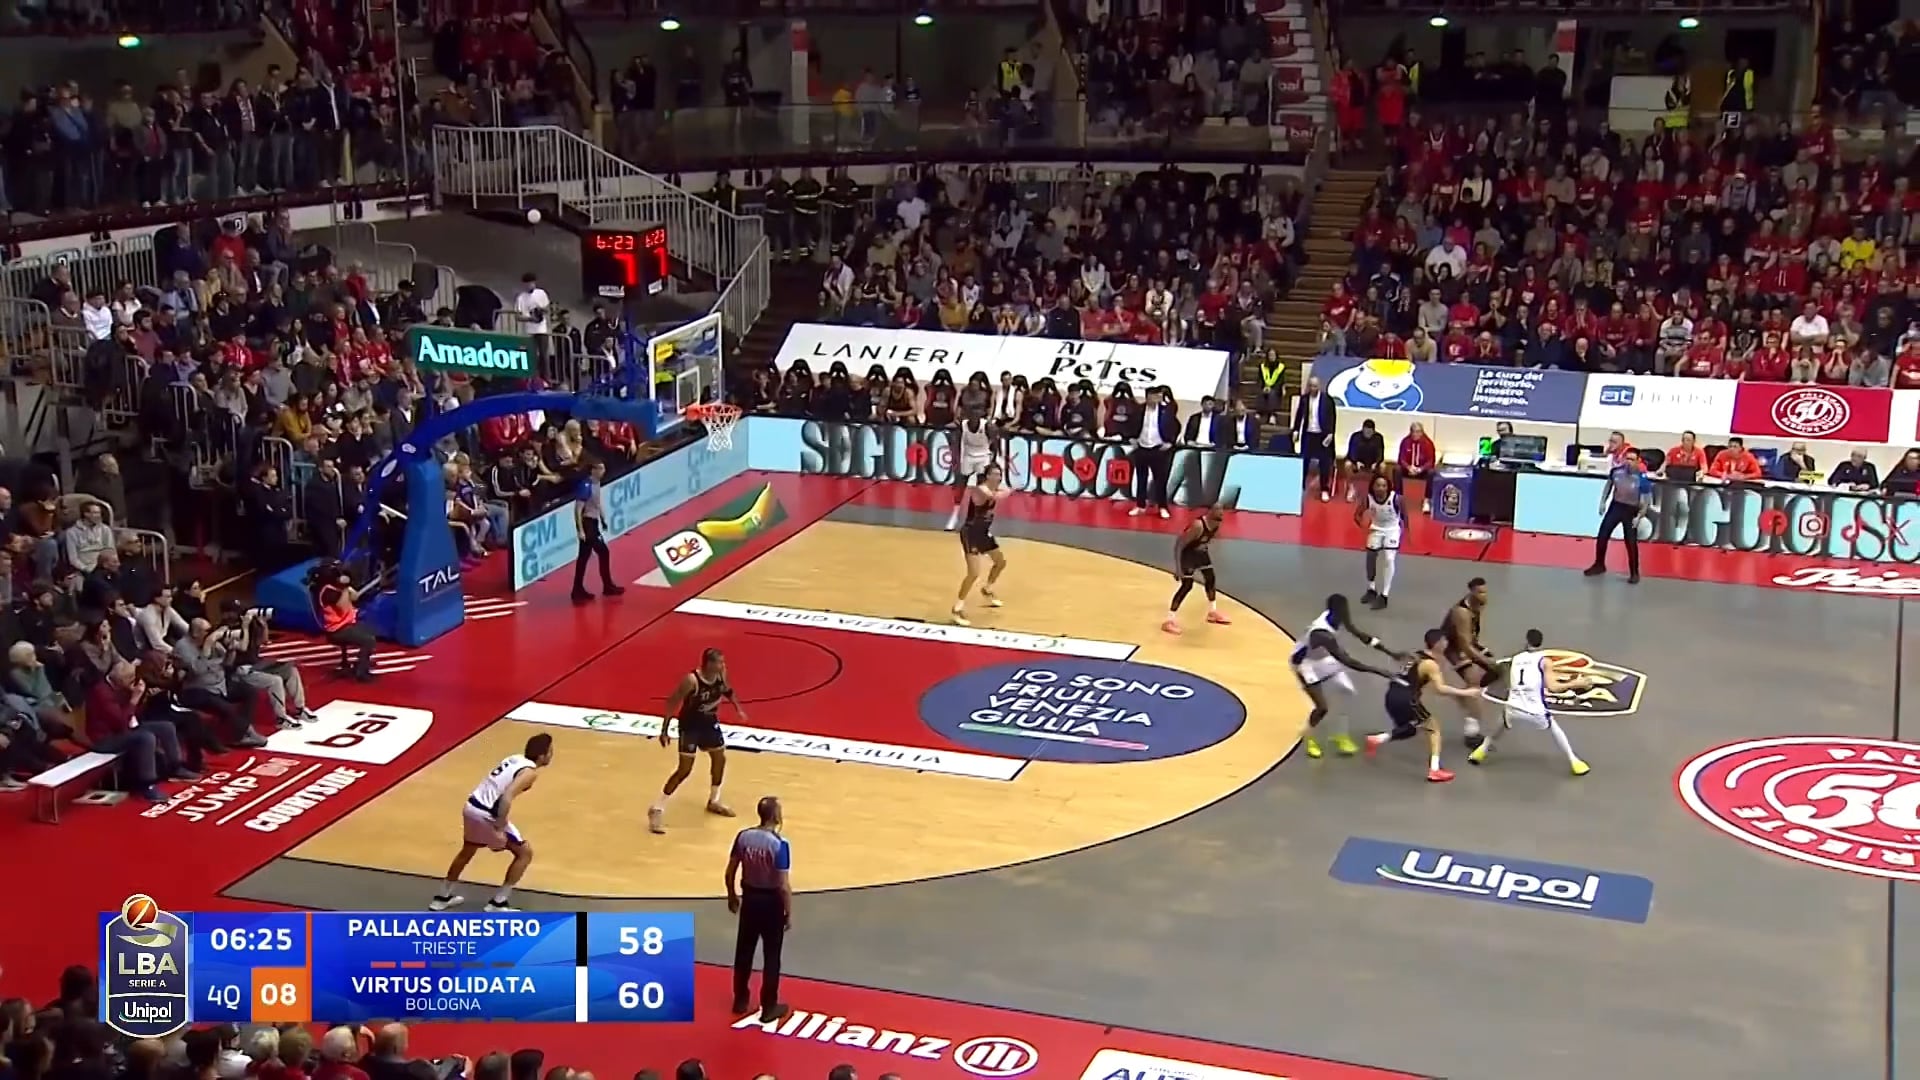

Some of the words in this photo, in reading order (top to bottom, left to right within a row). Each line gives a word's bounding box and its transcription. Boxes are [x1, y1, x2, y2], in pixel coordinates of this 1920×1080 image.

[418, 335, 528, 370] Amadori
[812, 341, 964, 364] LANIERI
[1049, 357, 1157, 382] PeTes
[609, 471, 641, 509] CM
[521, 514, 558, 553] CM
[665, 537, 700, 561] Dole
[419, 566, 460, 592] TAL
[521, 552, 539, 582] G
[1012, 669, 1058, 683] IO
[1069, 674, 1194, 699] SONO
[1518, 668, 1525, 686] 1
[998, 681, 1112, 705] FRIULI
[970, 709, 1100, 736] GIULIA
[988, 695, 1151, 726] VENEZIA
[305, 712, 397, 748] bai
[724, 730, 831, 752] ENEZIA
[1826, 748, 1920, 767] PAL
[176, 776, 259, 822] JUMP
[244, 766, 368, 832] COURTSIDE
[1731, 806, 1915, 866] RIESTE
[1402, 850, 1600, 902] Unipol
[731, 1006, 952, 1060] Allianz
